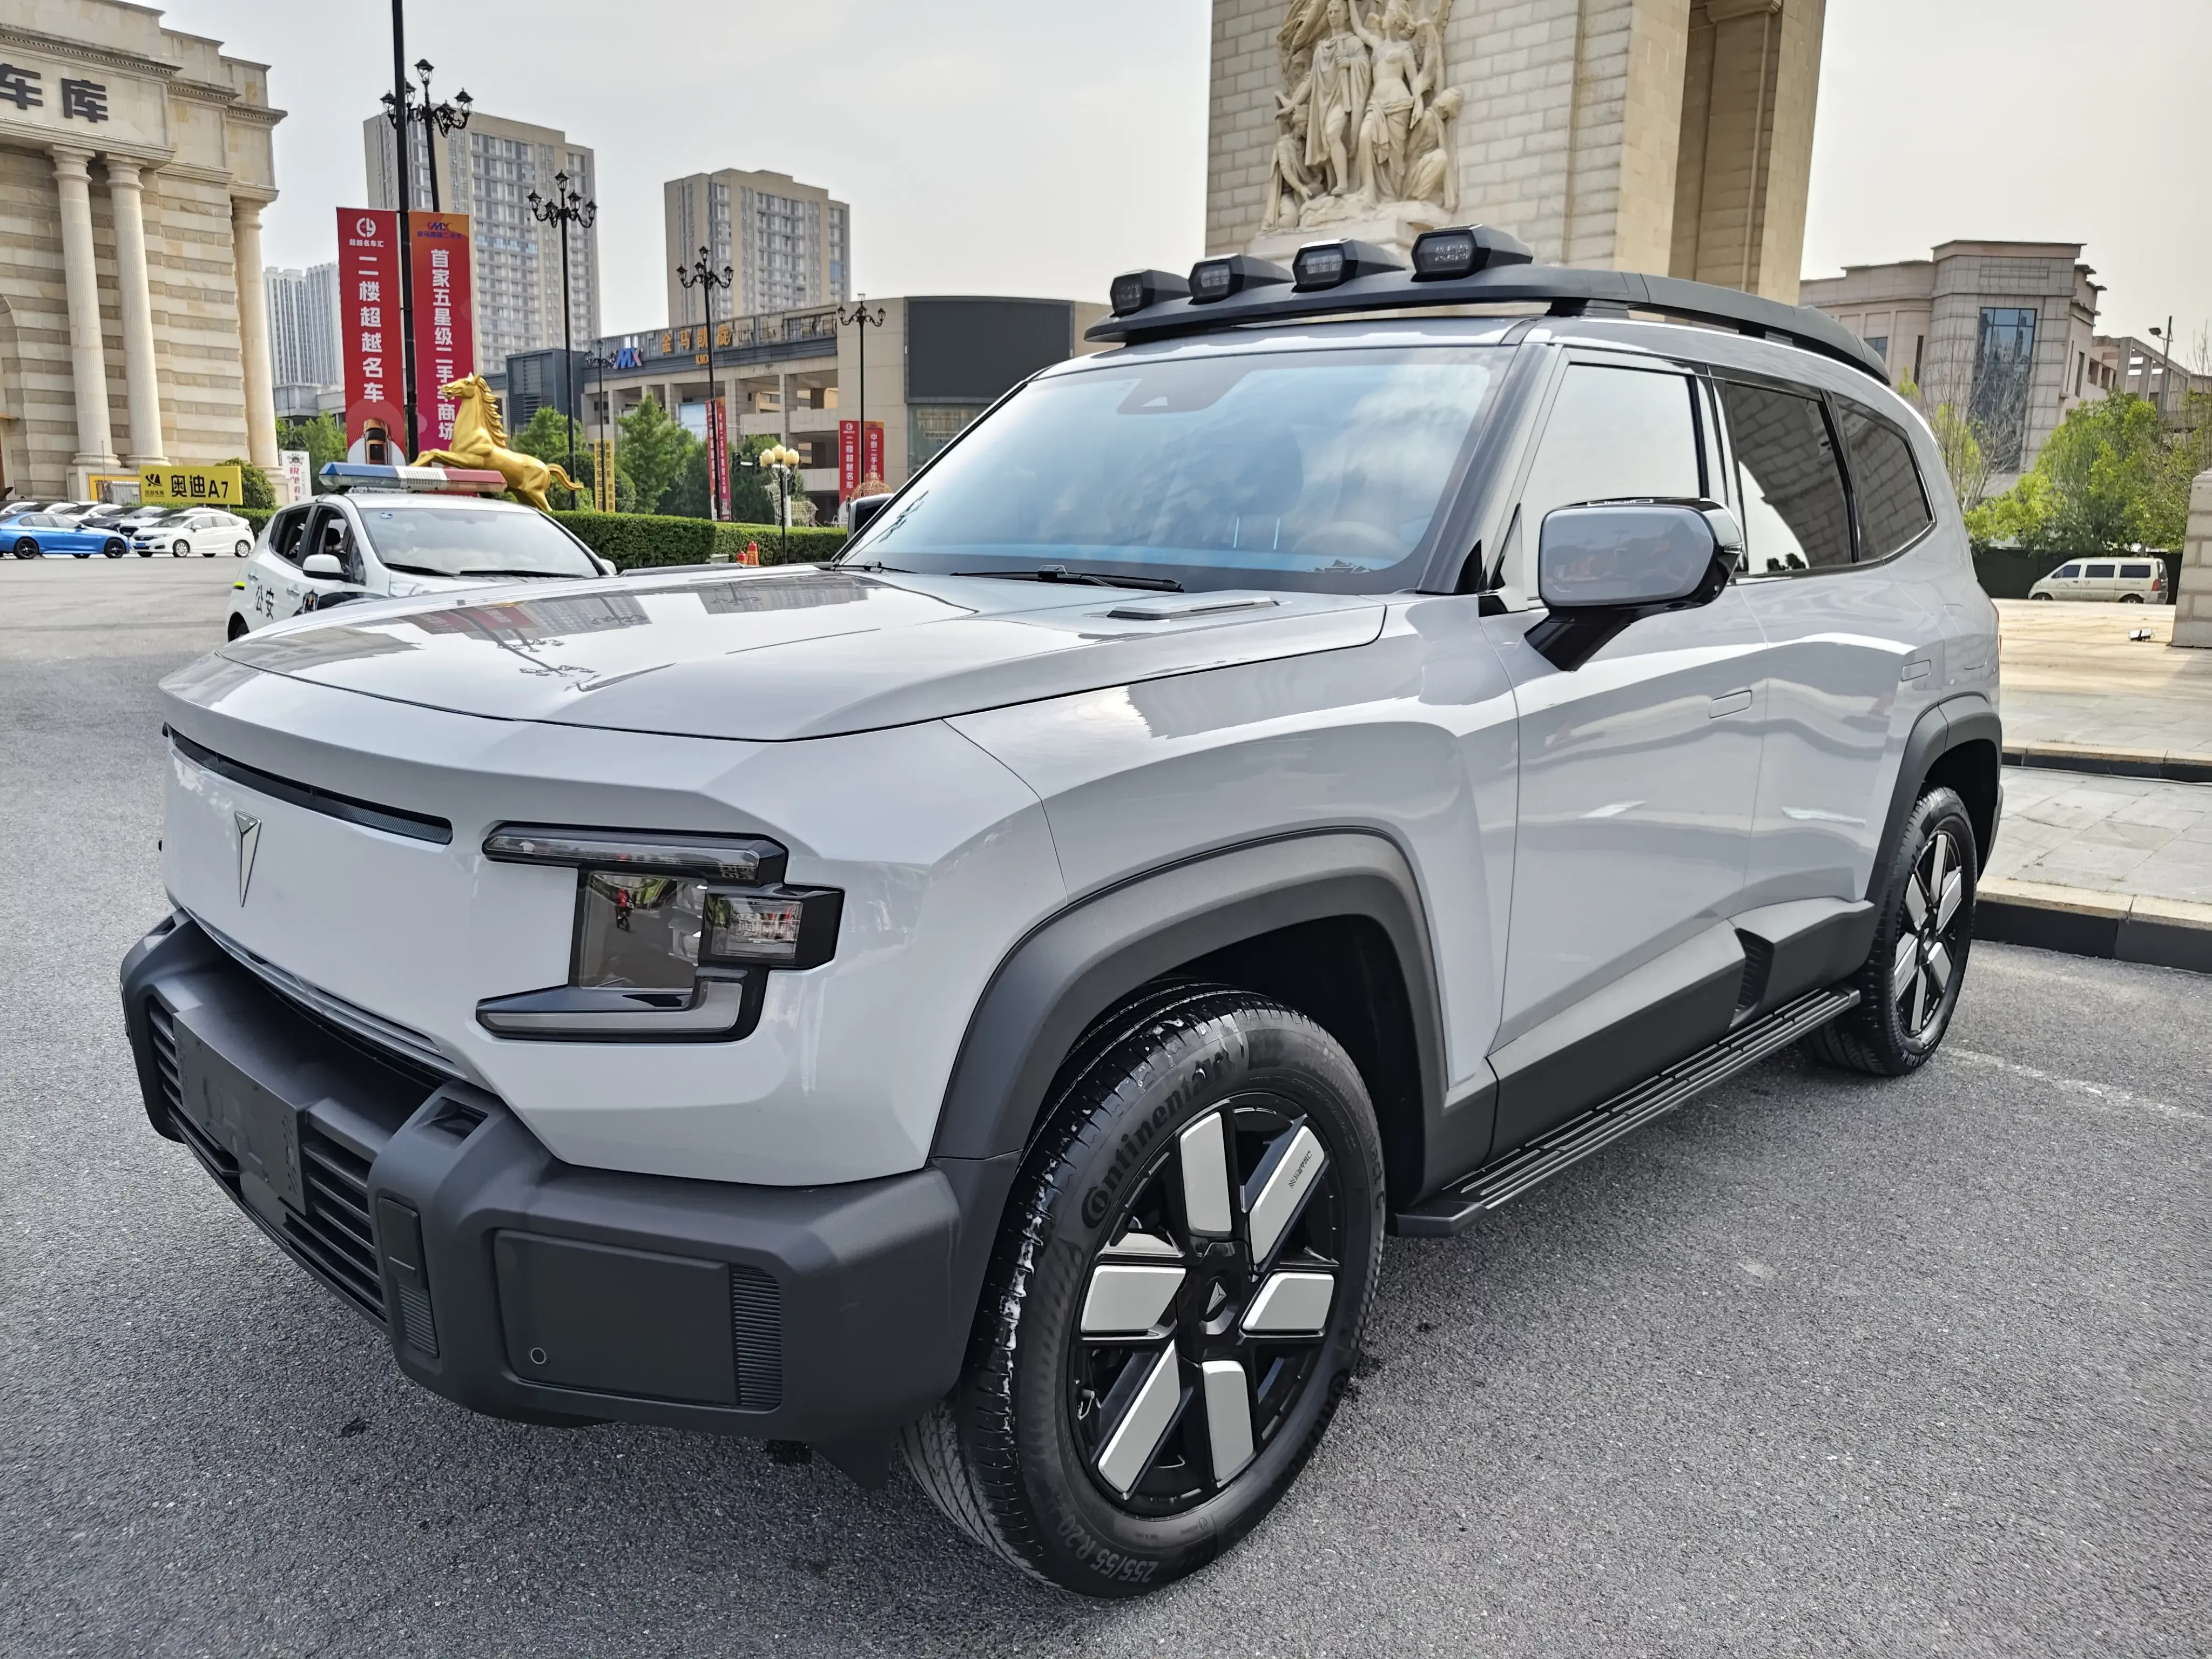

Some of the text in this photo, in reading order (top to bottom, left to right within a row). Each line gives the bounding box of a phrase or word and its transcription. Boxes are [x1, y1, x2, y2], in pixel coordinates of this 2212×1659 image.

[0, 63, 108, 123] 车库
[358, 256, 384, 403] 二楼超越名车
[171, 475, 228, 498] 奥迪A7
[255, 584, 274, 621] 公安
[1081, 1057, 1215, 1229] Continental
[1090, 1548, 1158, 1582] 255/55
